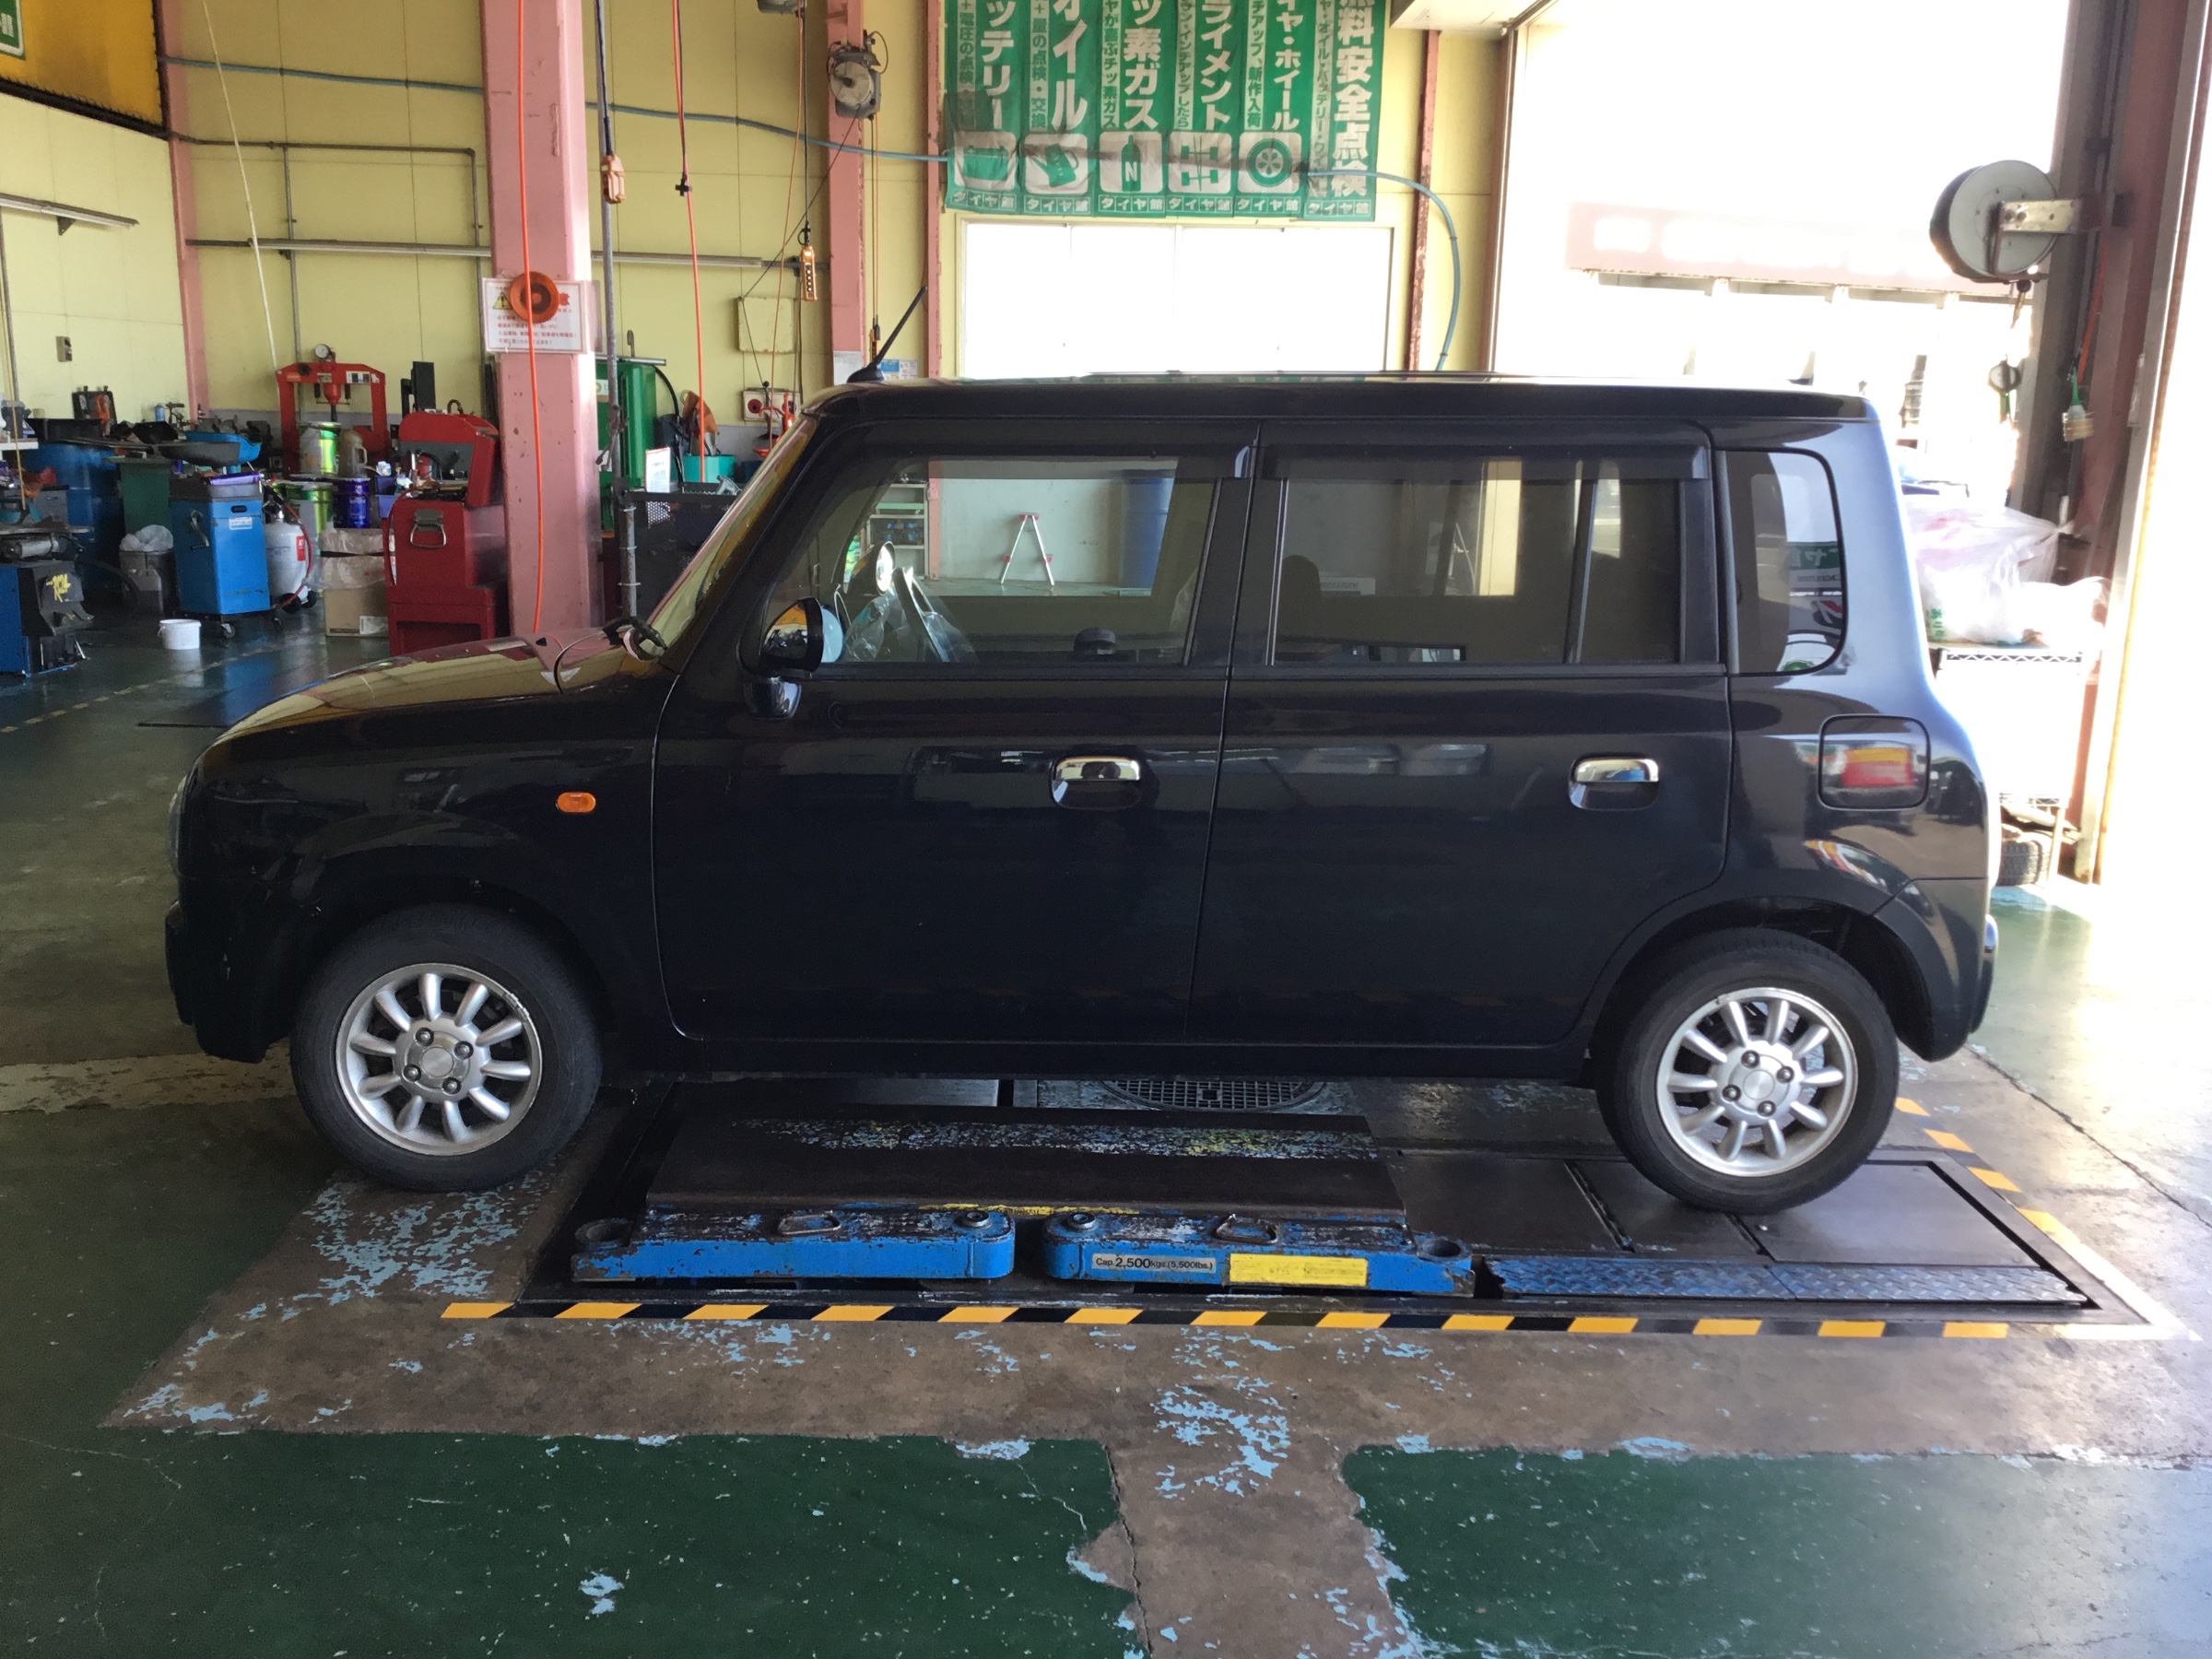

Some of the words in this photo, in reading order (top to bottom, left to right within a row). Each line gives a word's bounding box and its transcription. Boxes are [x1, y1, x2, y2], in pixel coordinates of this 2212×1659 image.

[1330, 0, 1373, 196] 料安全点検
[1125, 161, 1137, 182] N
[1027, 198, 1088, 212] タイヤ館
[1100, 197, 1163, 211] タイヤ館
[1169, 197, 1231, 211] タイヤ館
[1237, 197, 1299, 211] タイヤ館
[1308, 201, 1370, 214] タイヤ館
